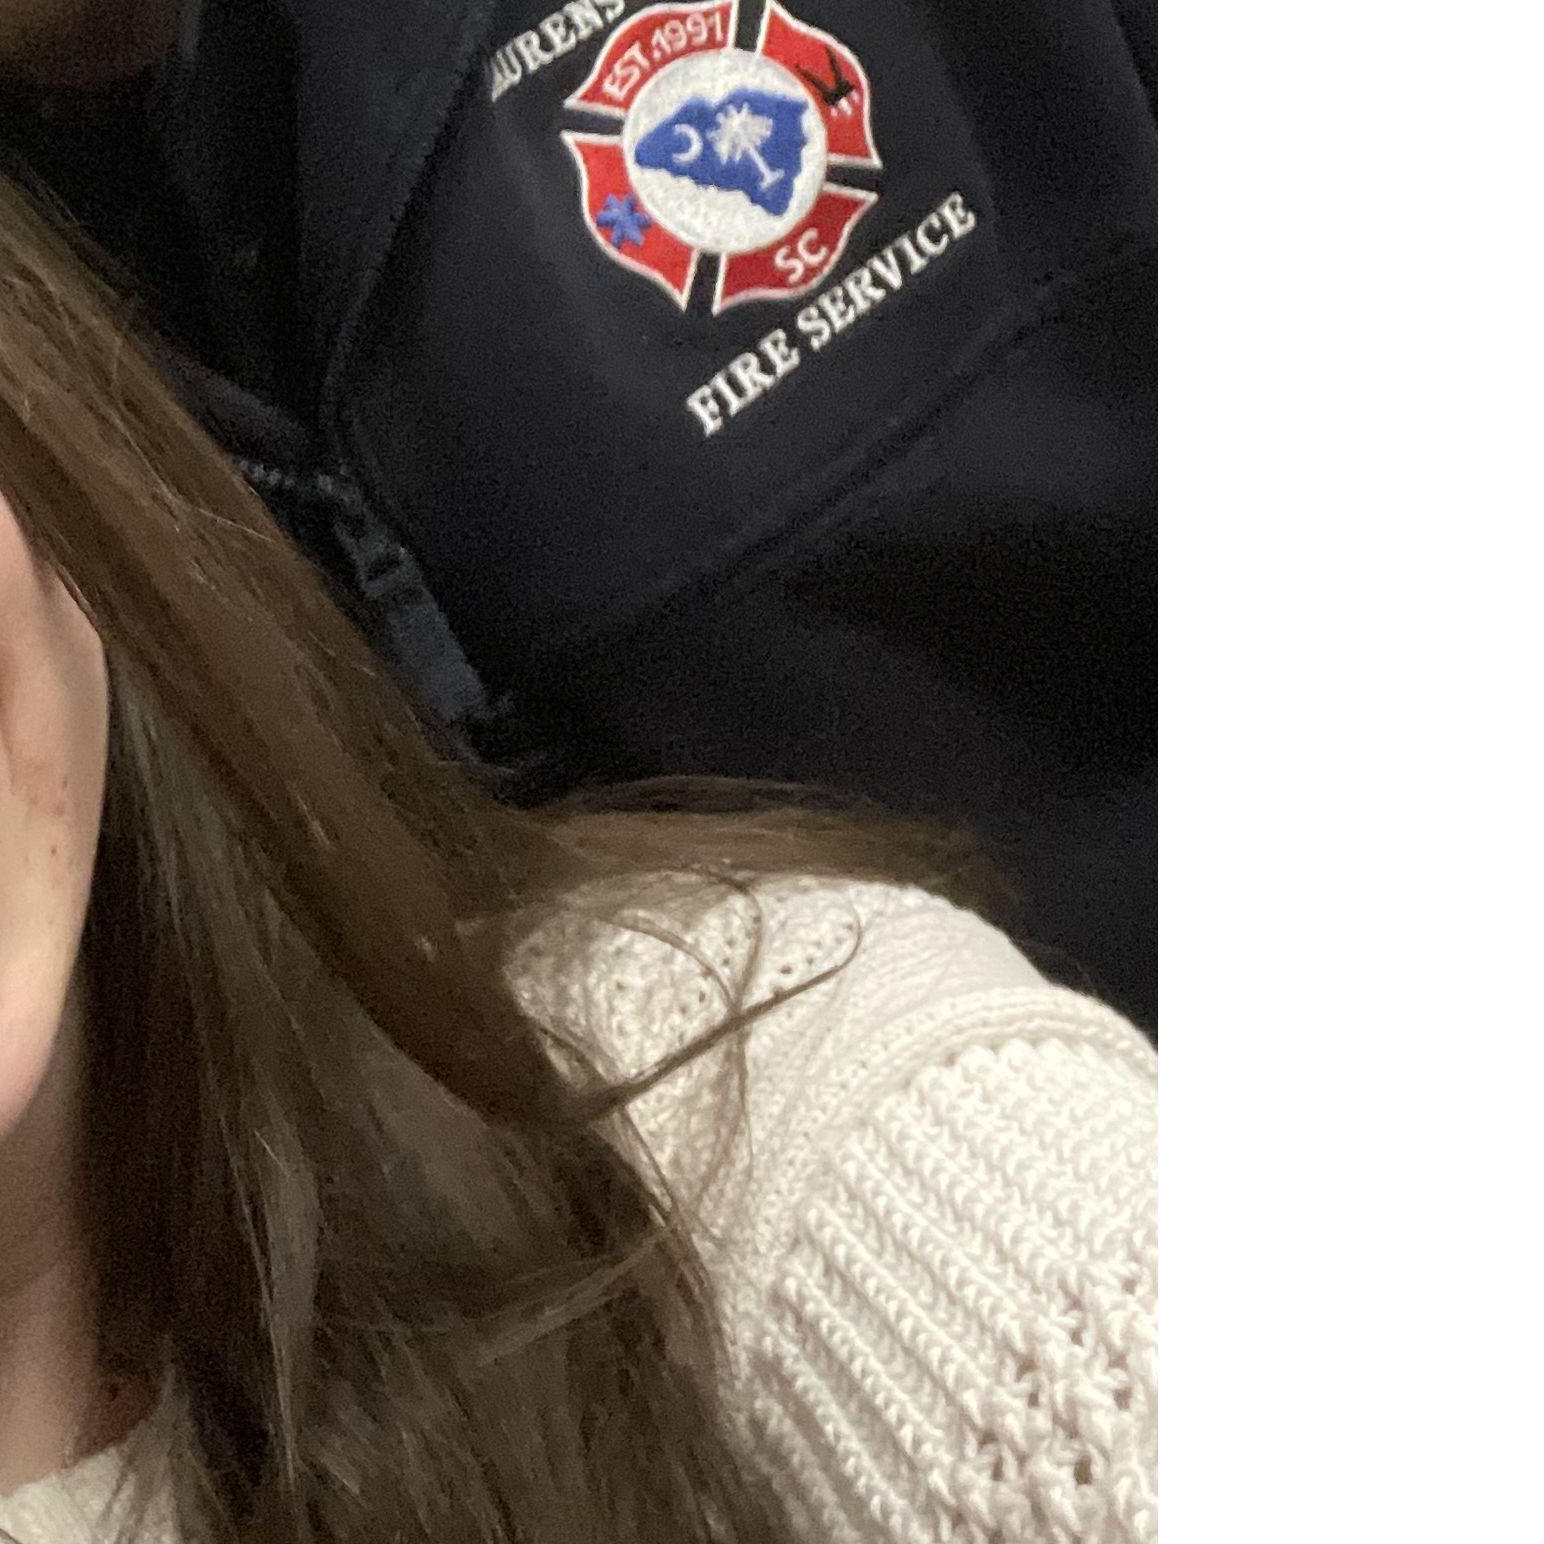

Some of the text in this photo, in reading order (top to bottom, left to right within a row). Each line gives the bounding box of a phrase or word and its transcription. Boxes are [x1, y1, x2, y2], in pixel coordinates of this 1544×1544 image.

[686, 191, 976, 437] FIRE SERVICE
[774, 227, 828, 284] SC
